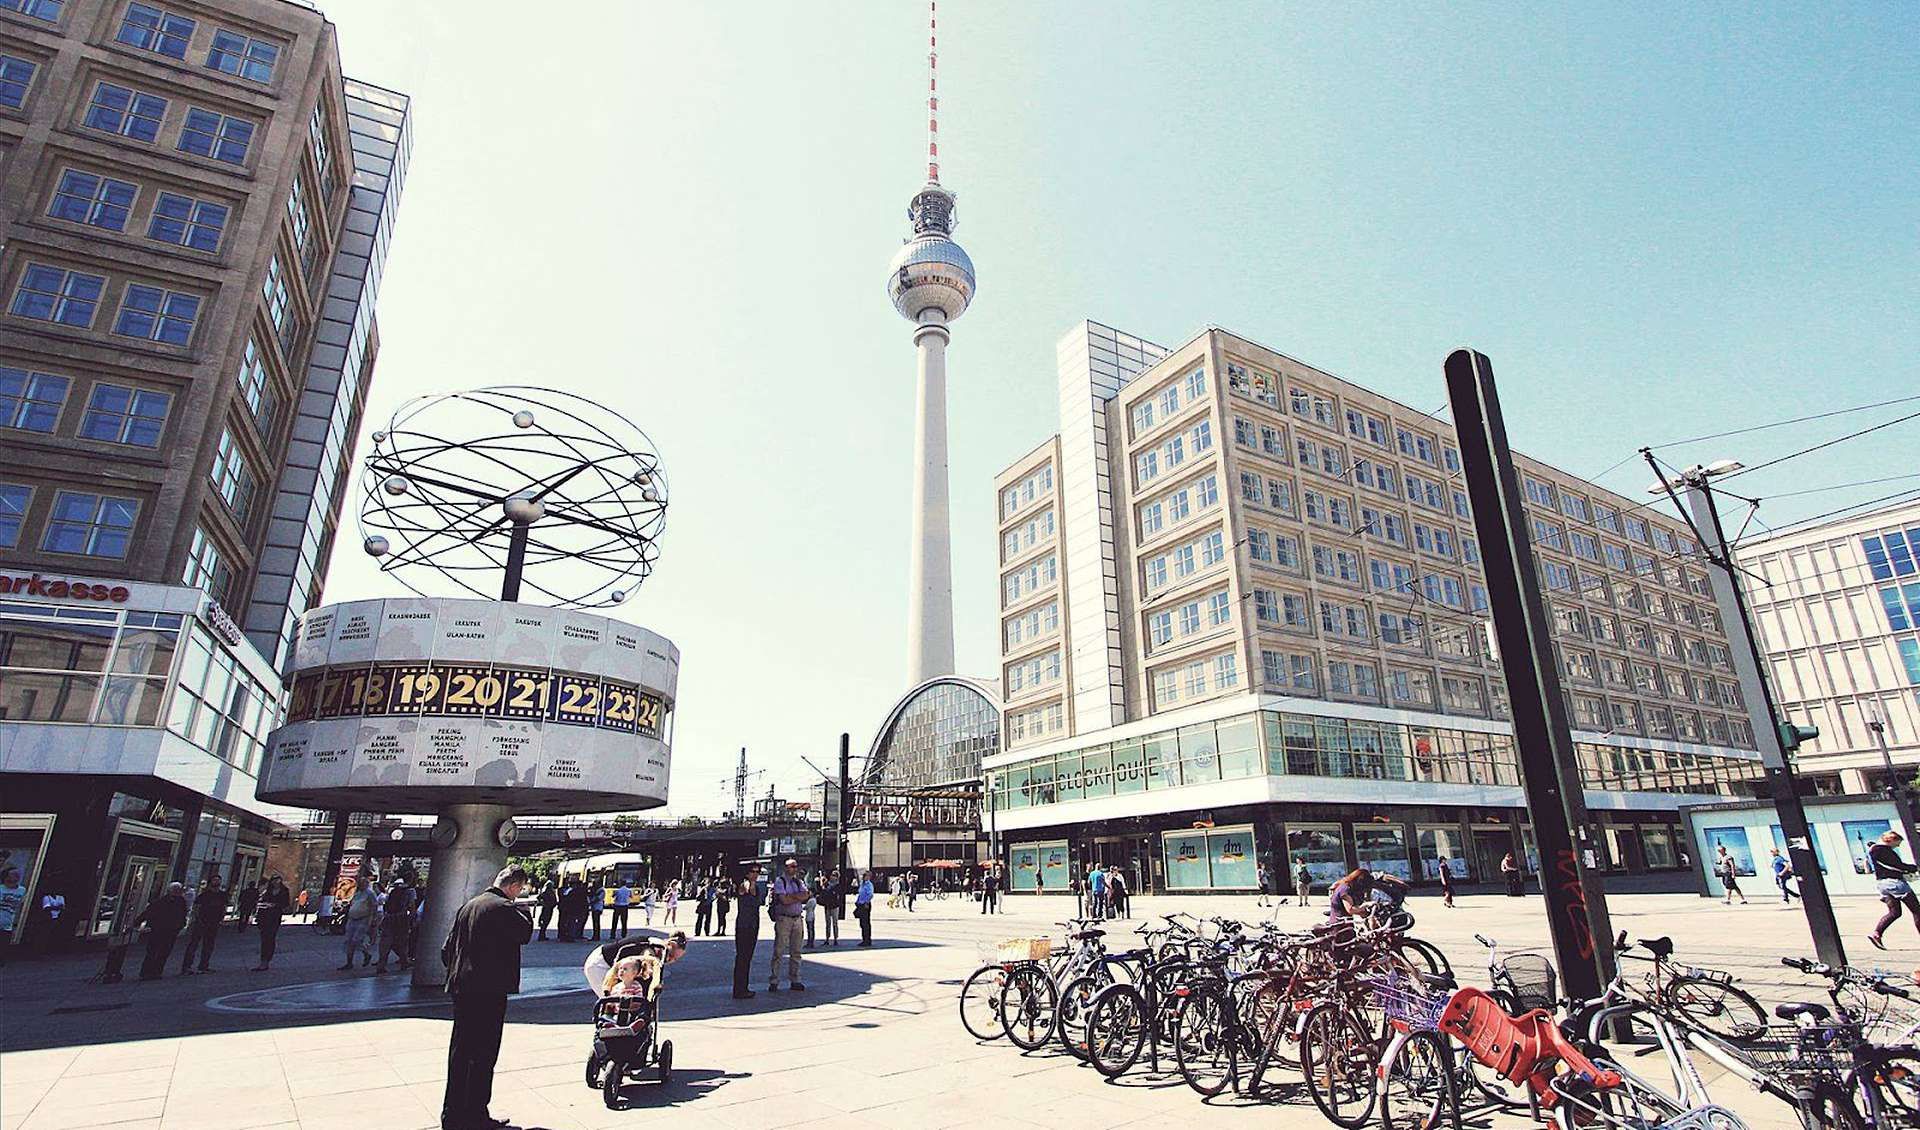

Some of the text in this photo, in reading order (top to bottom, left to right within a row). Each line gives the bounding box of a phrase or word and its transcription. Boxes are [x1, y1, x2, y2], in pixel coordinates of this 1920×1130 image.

[0, 574, 129, 603] arkasse
[351, 674, 386, 706] 18
[400, 673, 442, 705] 19
[447, 673, 503, 708] 20
[509, 678, 548, 708] 21
[560, 683, 602, 716] 22
[604, 690, 637, 722] 23
[637, 698, 659, 729] 24
[1179, 841, 1195, 855] dm
[1224, 839, 1243, 855] dm
[341, 857, 362, 866] KFC
